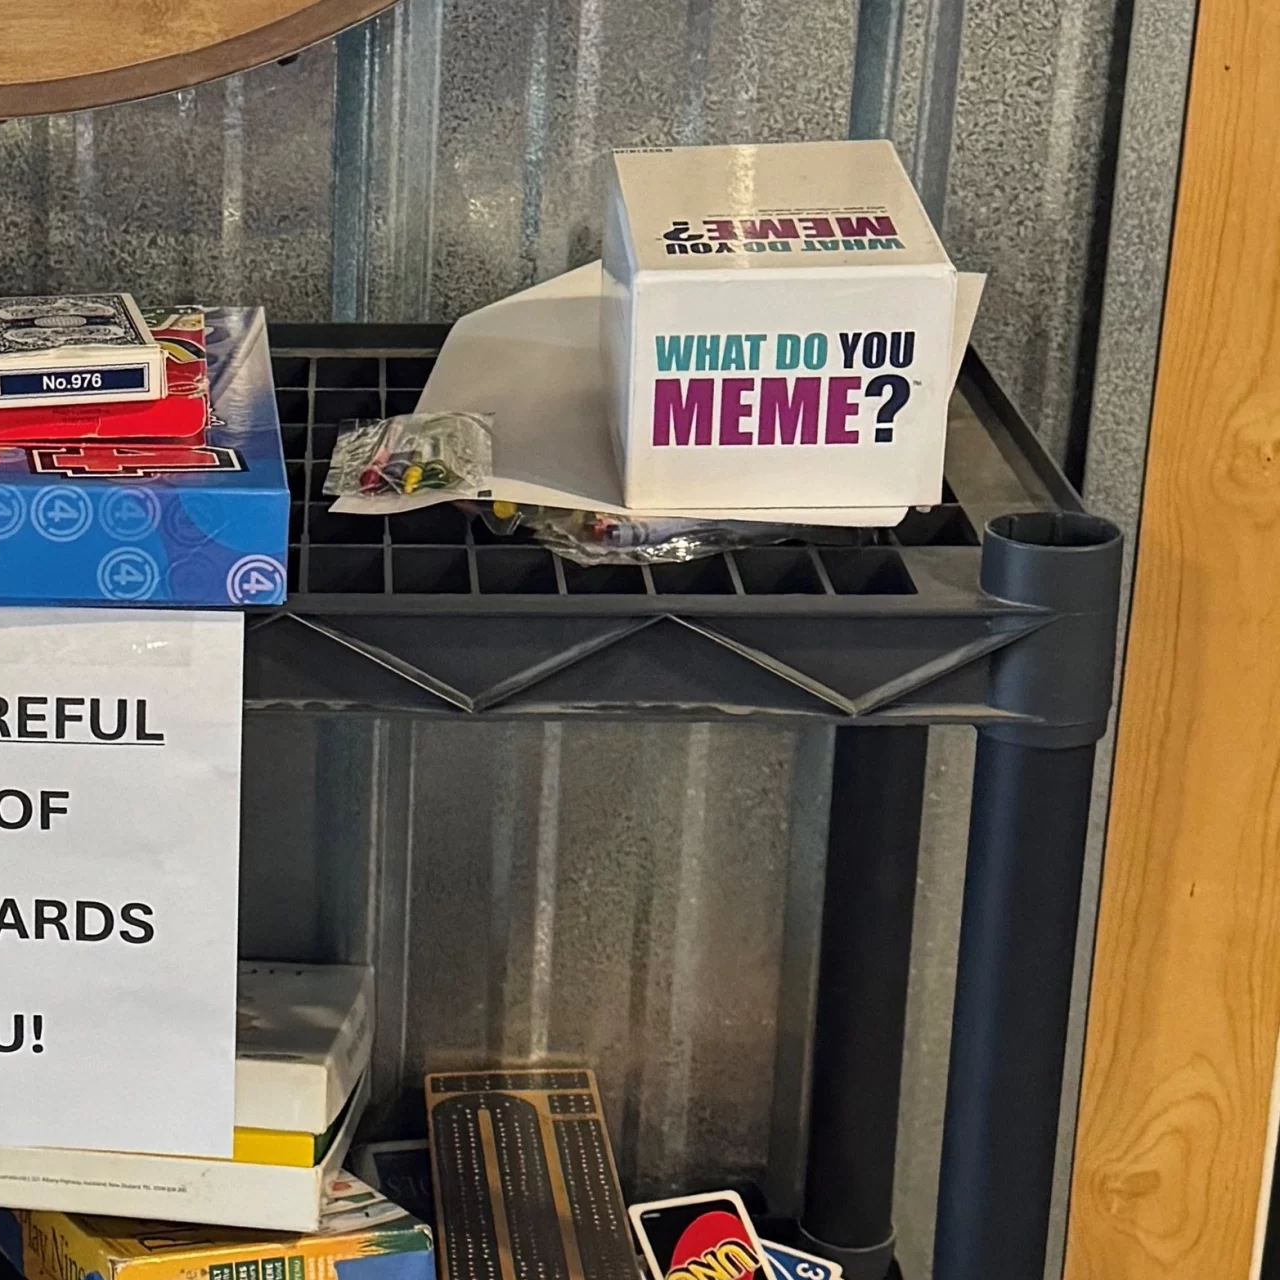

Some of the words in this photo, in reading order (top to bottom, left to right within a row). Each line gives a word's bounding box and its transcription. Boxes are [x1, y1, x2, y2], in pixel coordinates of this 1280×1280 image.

[663, 215, 898, 242] MEME?
[665, 241, 736, 255] YOU
[744, 239, 793, 253] DO
[801, 238, 907, 252] WHAT
[655, 333, 767, 372] WHAT
[775, 332, 829, 371] DO
[839, 331, 916, 369] YOU
[41, 372, 102, 391] No.976
[652, 374, 912, 446] MEME?
